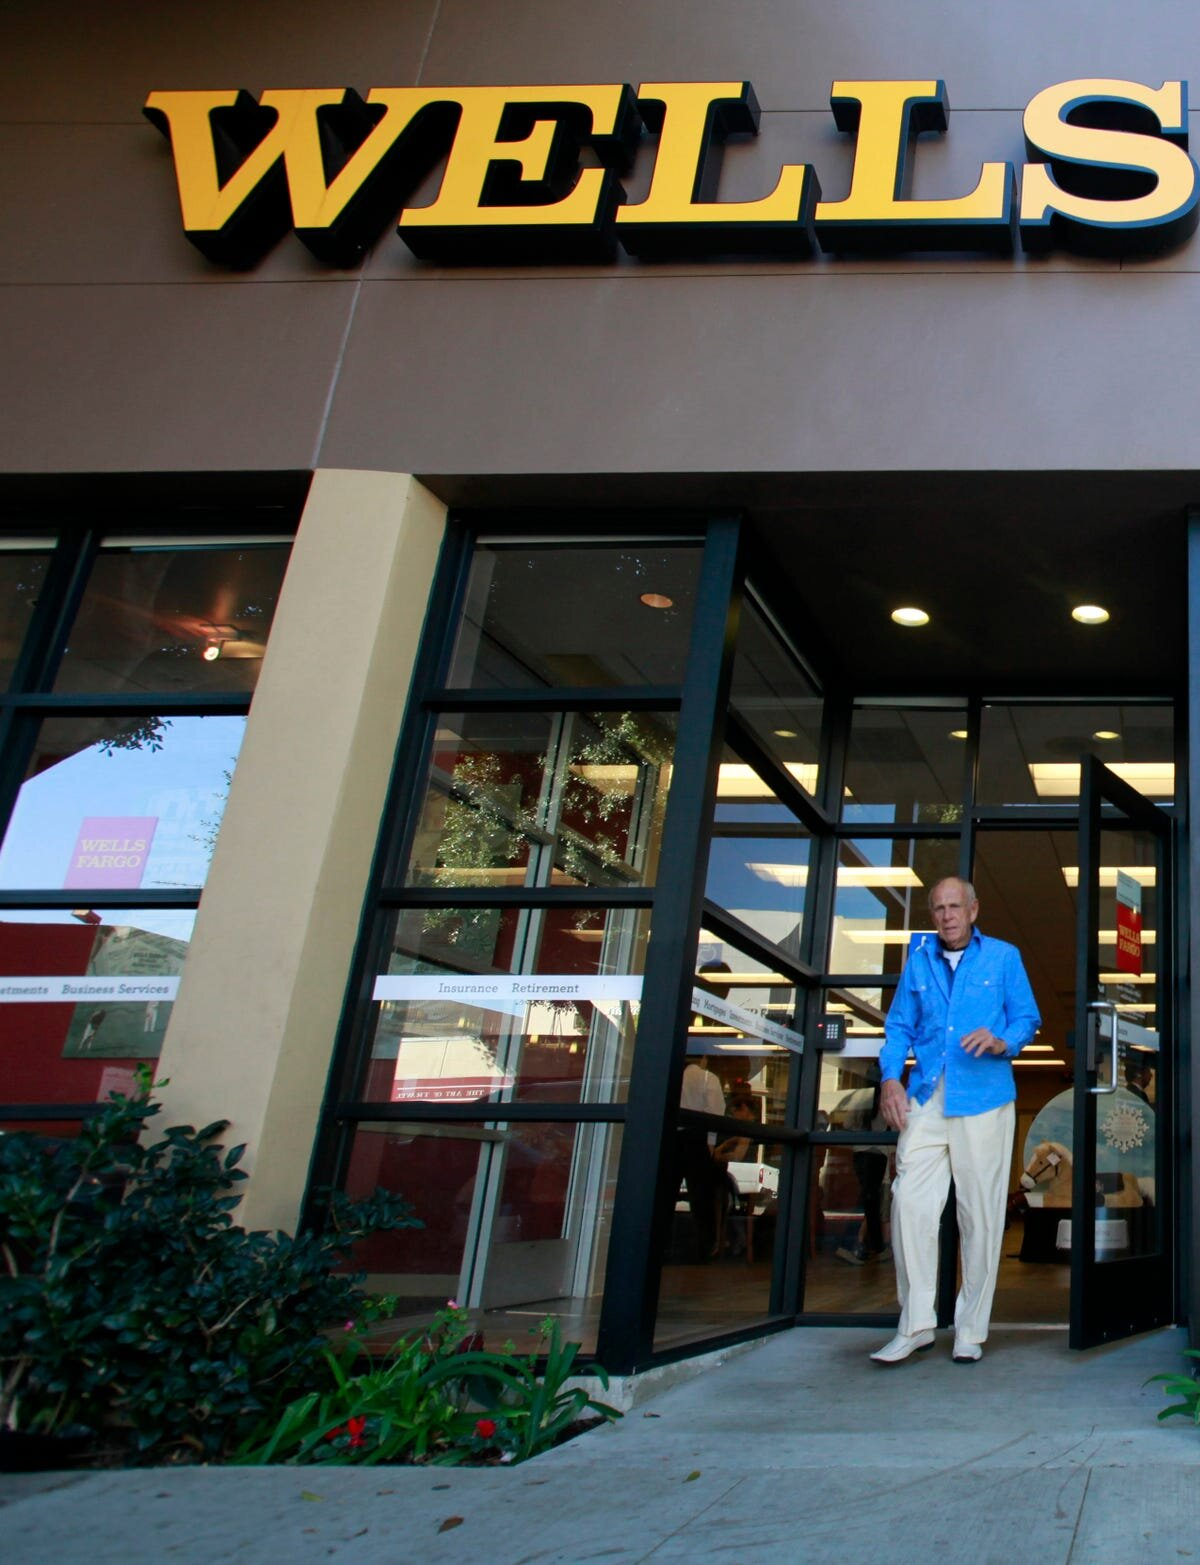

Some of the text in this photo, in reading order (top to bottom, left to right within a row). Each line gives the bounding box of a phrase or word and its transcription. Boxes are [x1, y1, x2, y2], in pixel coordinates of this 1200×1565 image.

[144, 78, 1198, 236] WELLS
[81, 839, 147, 852] WELLS
[76, 855, 141, 868] FARGO
[61, 984, 114, 995] Business
[117, 983, 169, 995] Services
[438, 982, 580, 993] Insurance Retirement
